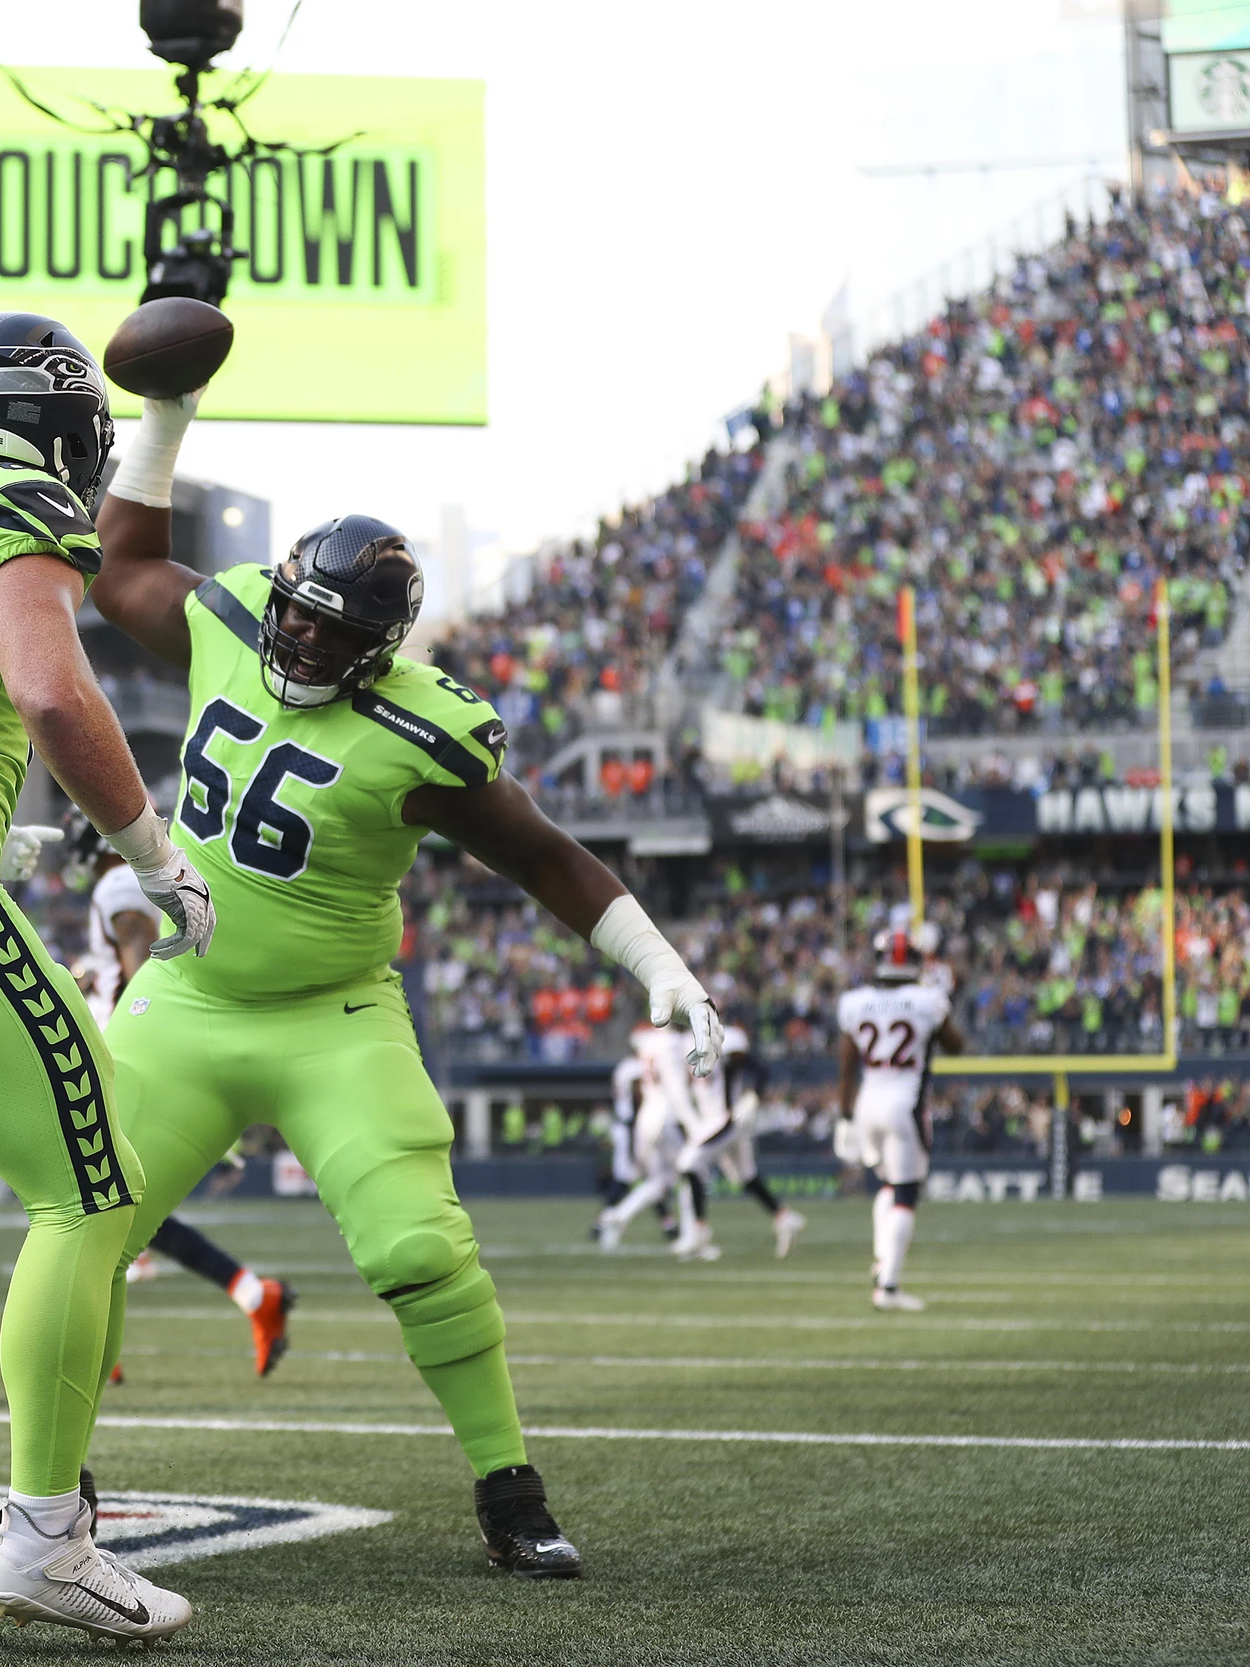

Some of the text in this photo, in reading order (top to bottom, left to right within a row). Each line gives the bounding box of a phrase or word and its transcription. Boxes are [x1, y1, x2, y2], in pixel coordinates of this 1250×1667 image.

[373, 704, 437, 744] SEAHAWKS
[176, 694, 345, 883] 66
[1037, 785, 1218, 833] HAWKS
[859, 1021, 916, 1068] 22
[72, 1555, 93, 1575] ALPHA
